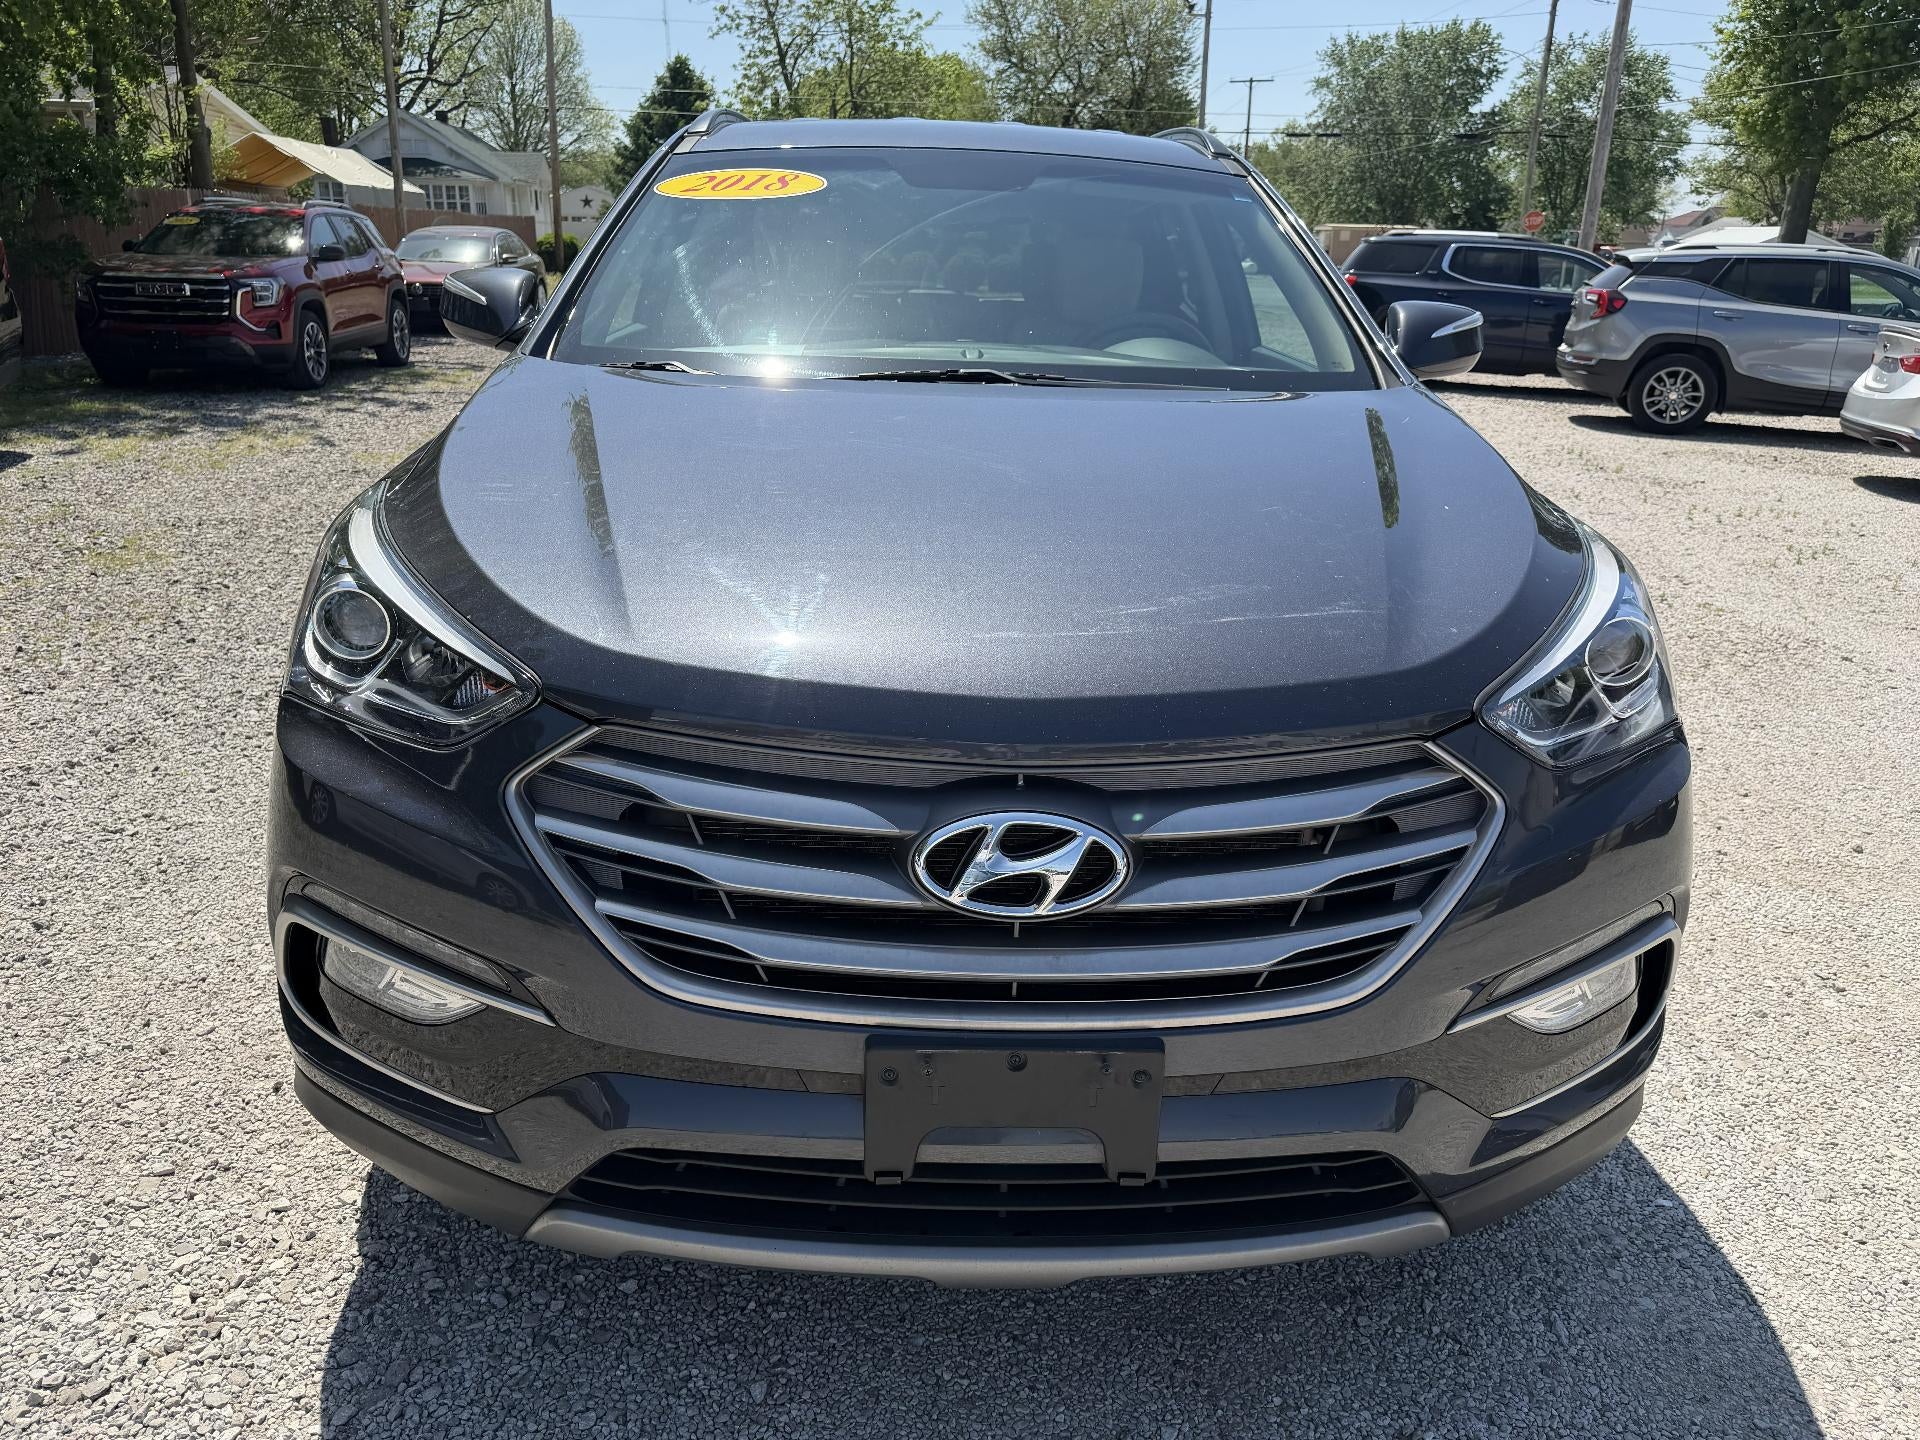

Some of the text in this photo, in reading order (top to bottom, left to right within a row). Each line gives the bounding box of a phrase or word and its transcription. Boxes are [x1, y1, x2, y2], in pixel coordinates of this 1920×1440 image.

[680, 174, 800, 193] 2018
[1524, 215, 1543, 225] STOP
[135, 281, 190, 296] GMC
